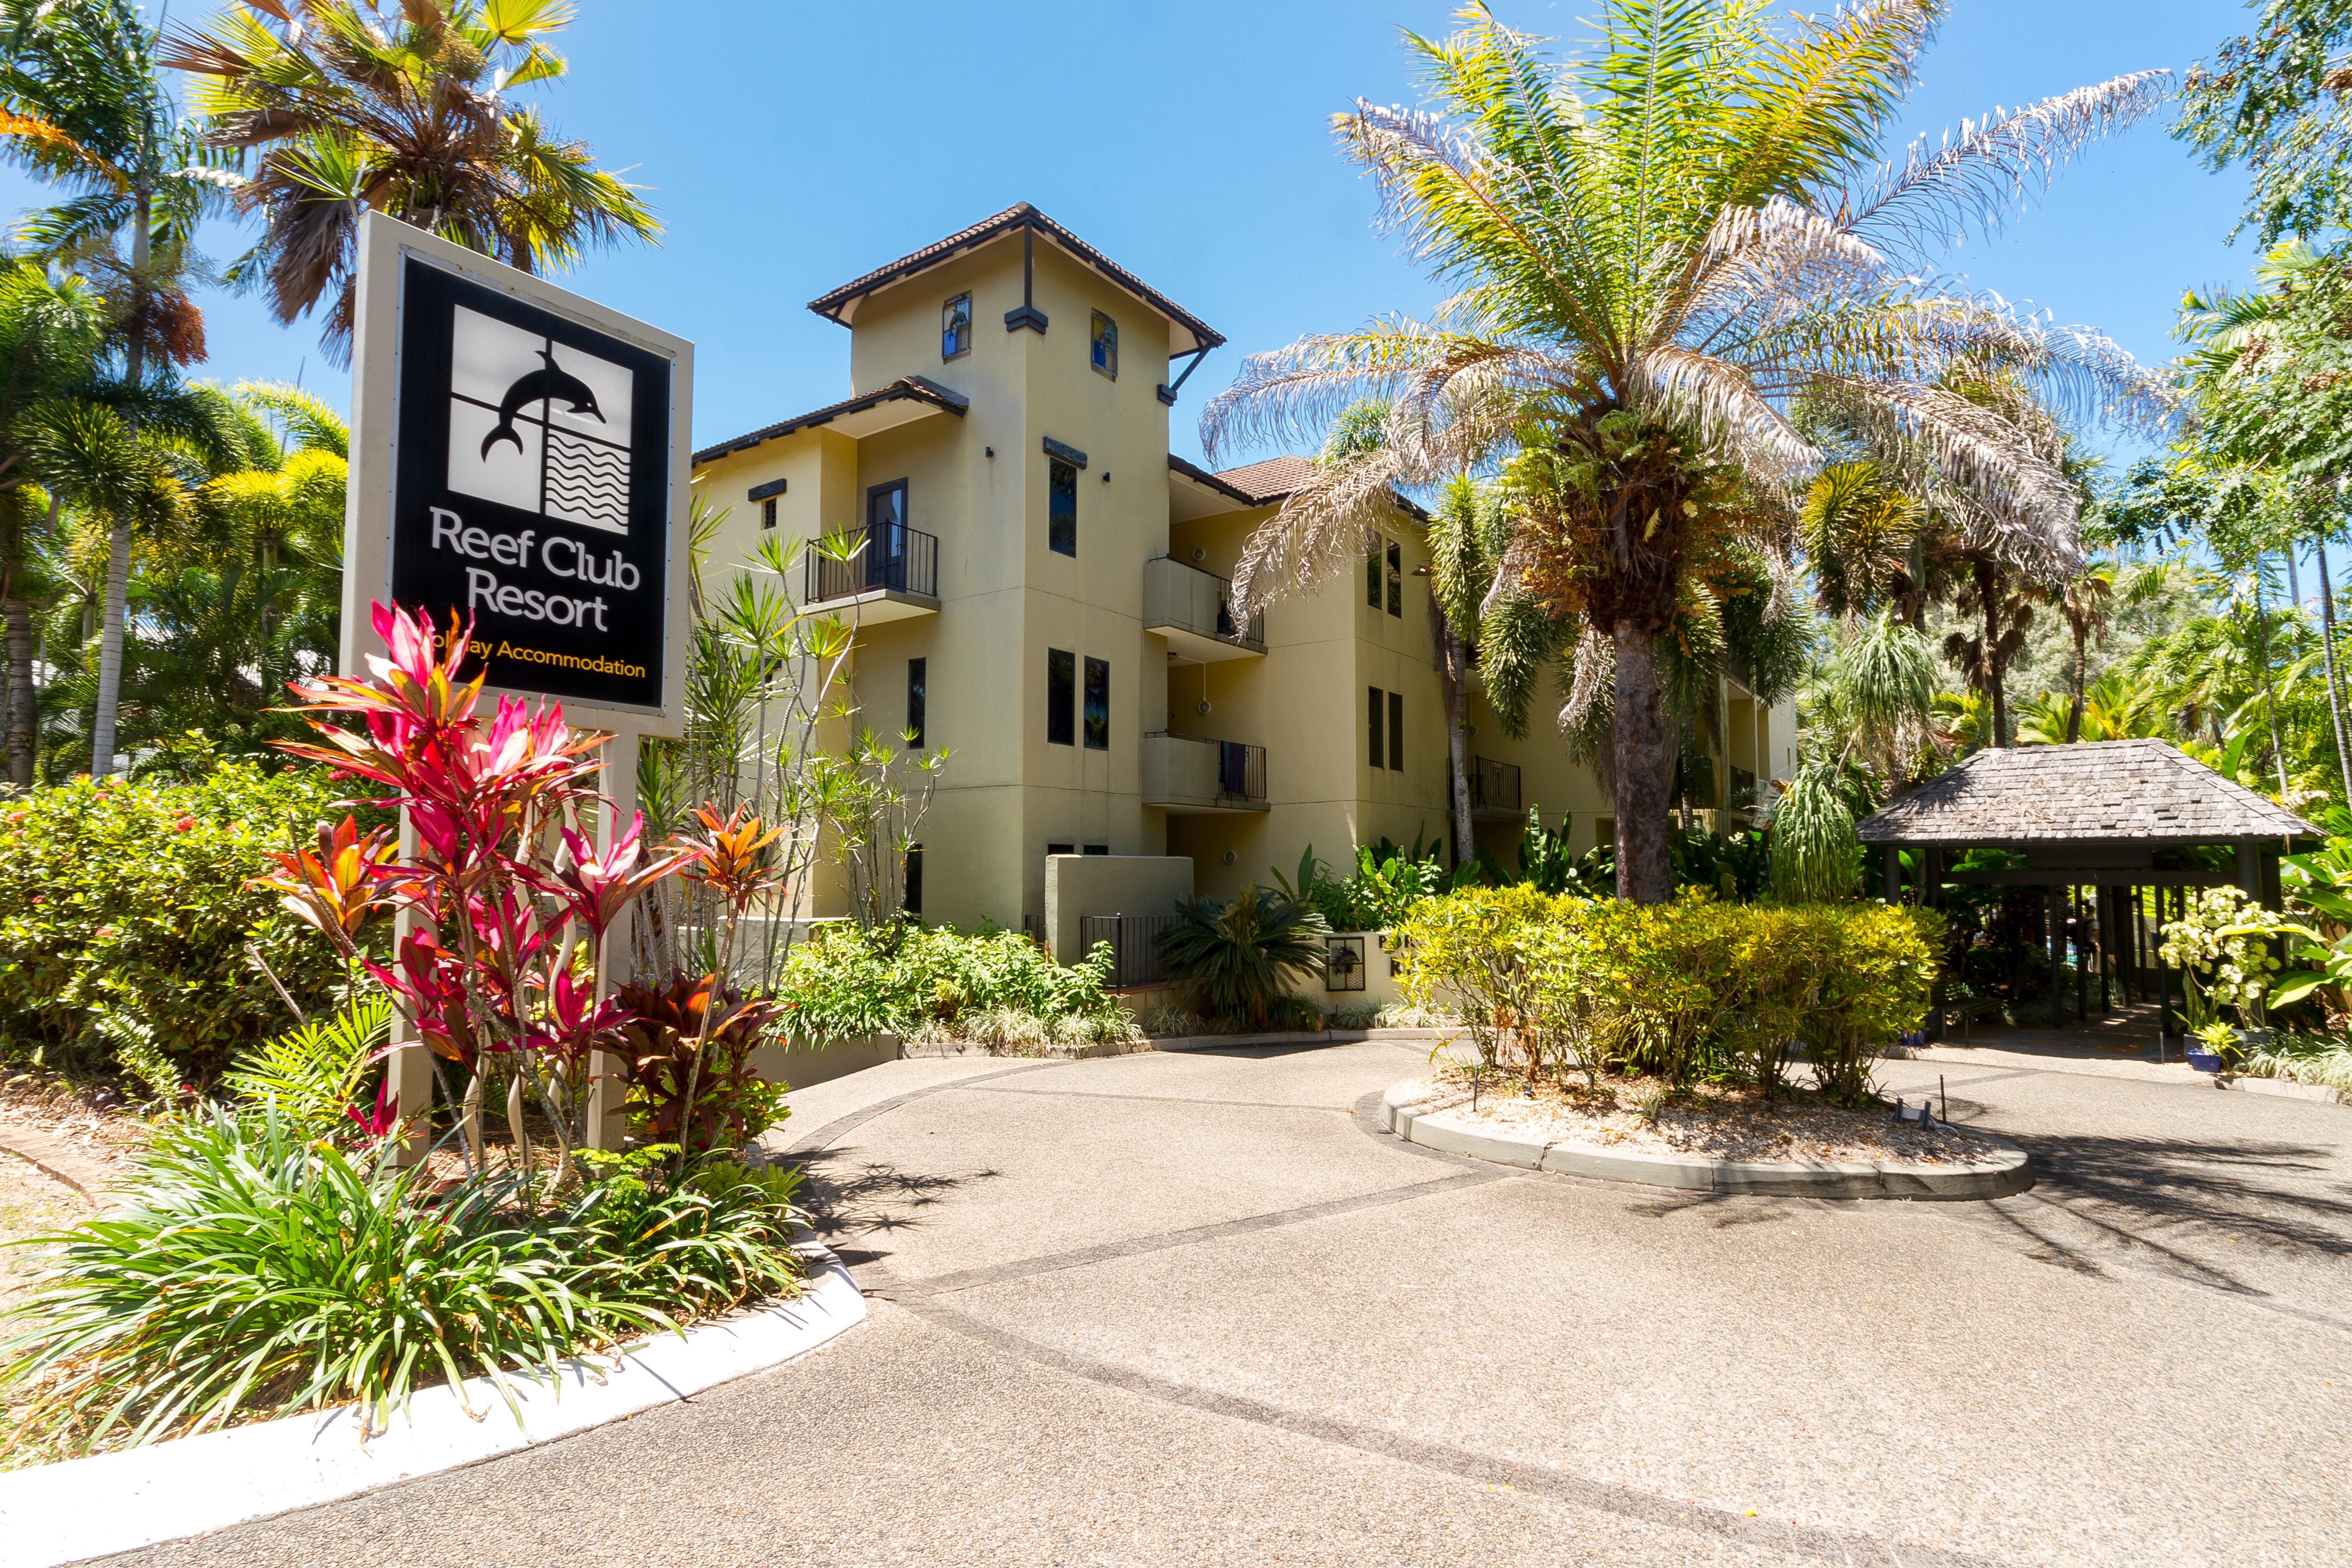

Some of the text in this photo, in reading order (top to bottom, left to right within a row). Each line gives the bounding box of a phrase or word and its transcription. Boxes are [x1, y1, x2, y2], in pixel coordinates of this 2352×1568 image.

[429, 506, 640, 590] Reef Club
[466, 567, 608, 632] Resort
[416, 626, 645, 678] olay Accommodation
